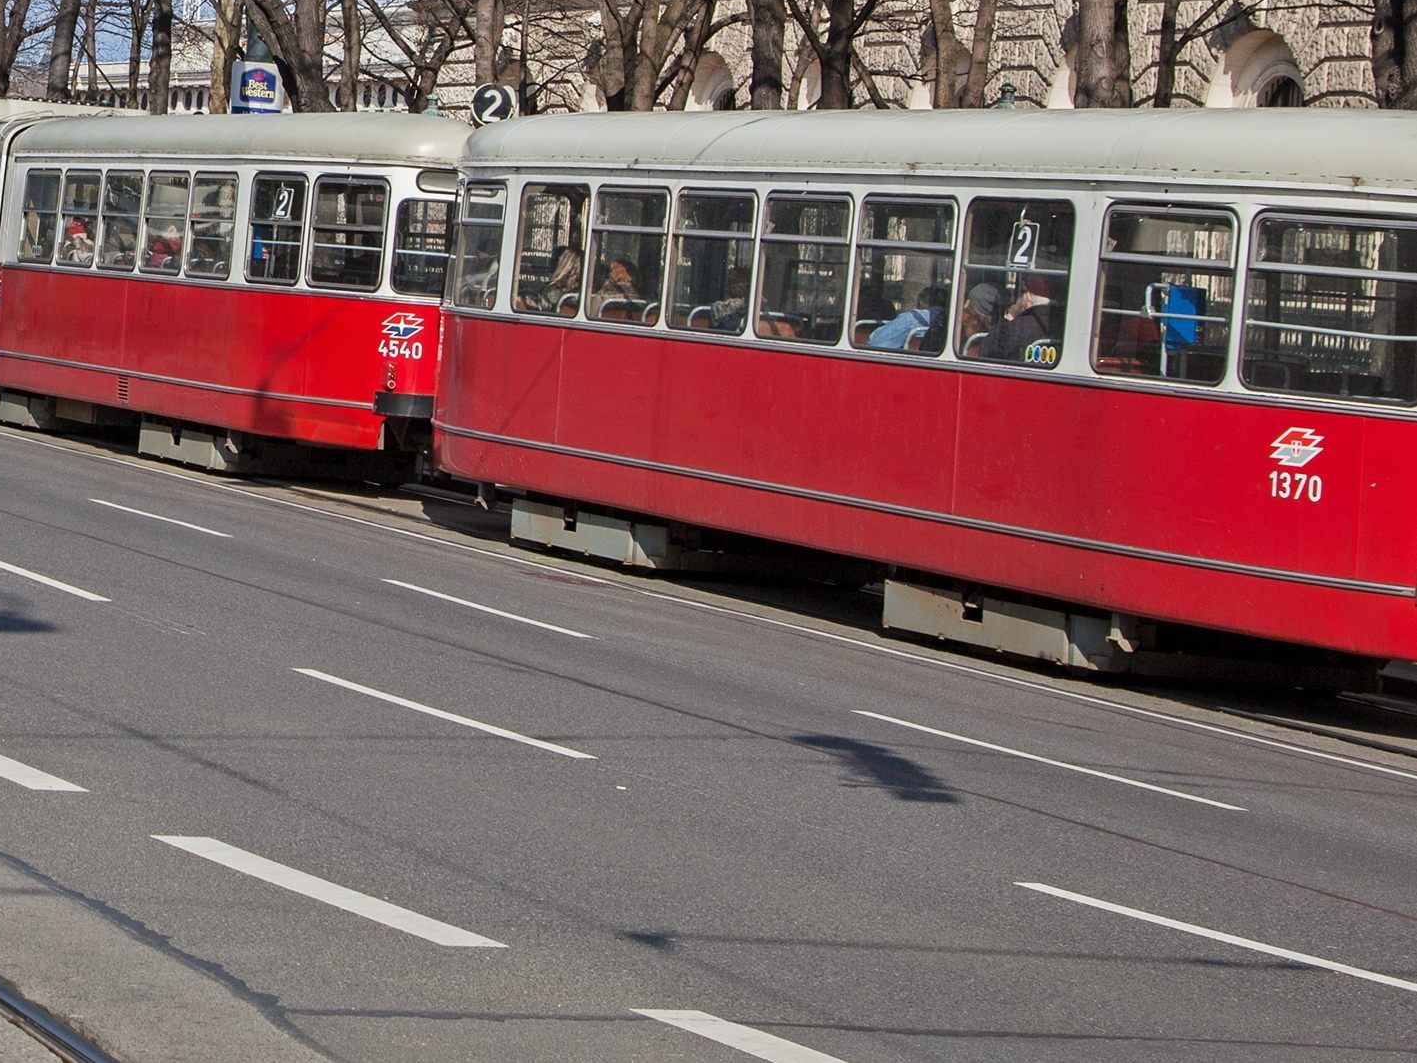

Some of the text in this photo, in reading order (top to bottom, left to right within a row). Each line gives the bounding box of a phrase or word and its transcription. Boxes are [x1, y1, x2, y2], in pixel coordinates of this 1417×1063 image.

[241, 87, 274, 99] Western
[248, 79, 268, 90] Best
[482, 90, 504, 123] 2
[277, 190, 288, 216] 2
[1014, 226, 1032, 263] 2
[378, 339, 423, 360] 4540
[1268, 470, 1323, 503] 1370
